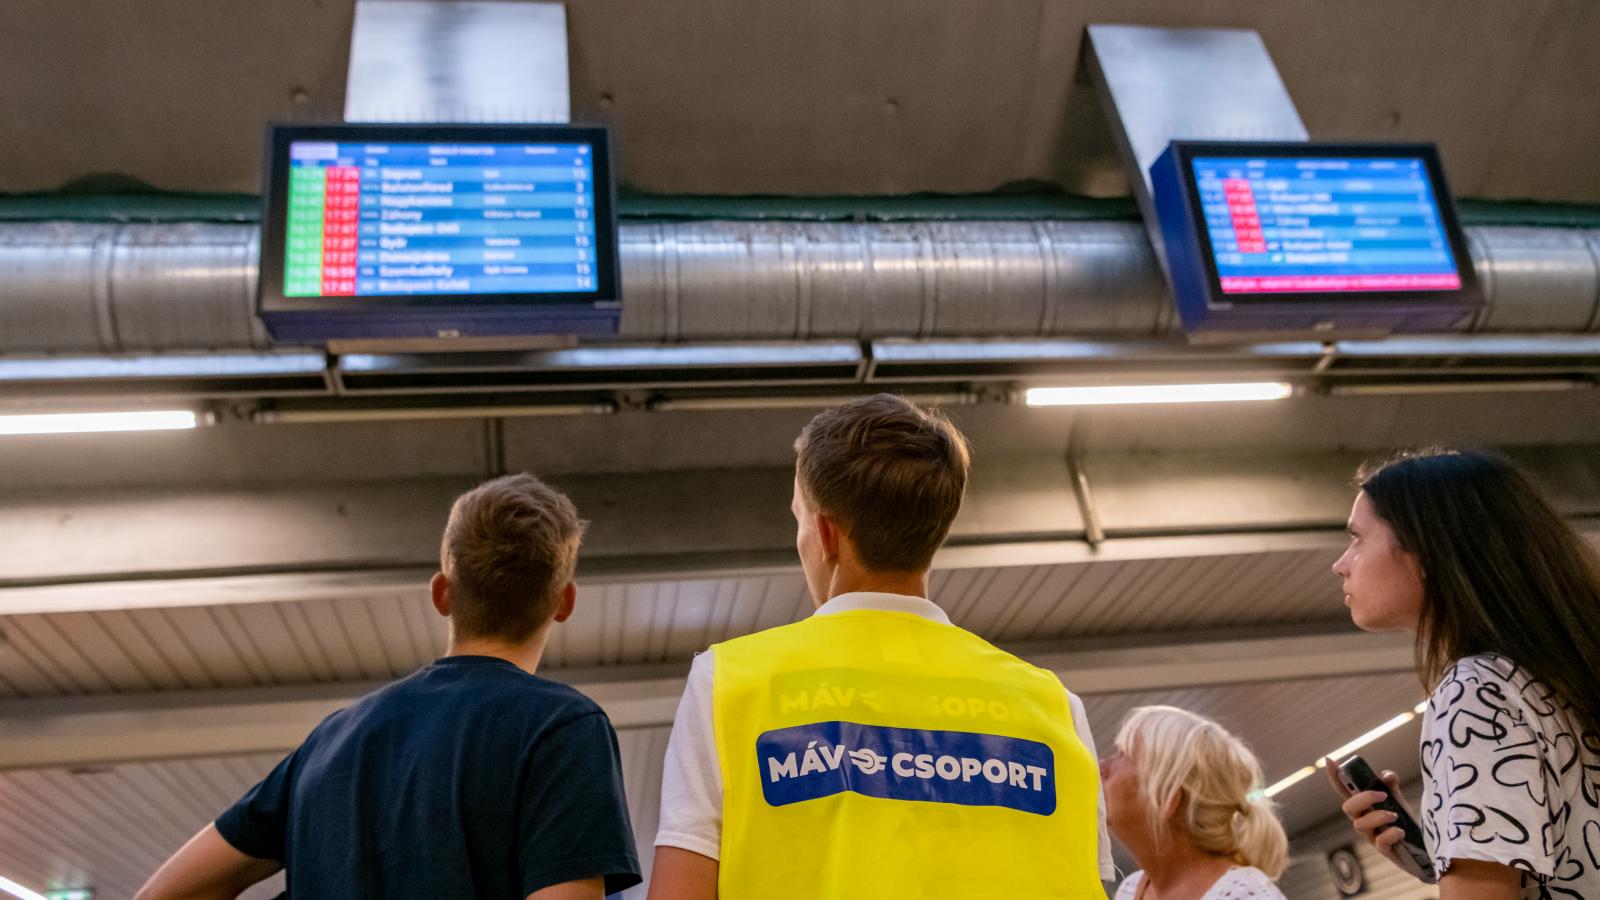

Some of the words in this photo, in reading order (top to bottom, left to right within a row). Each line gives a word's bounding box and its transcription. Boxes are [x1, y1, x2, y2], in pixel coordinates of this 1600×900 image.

[780, 682, 856, 715] MÁV
[768, 741, 845, 783] MÁV
[892, 753, 1047, 791] CSOPORT
